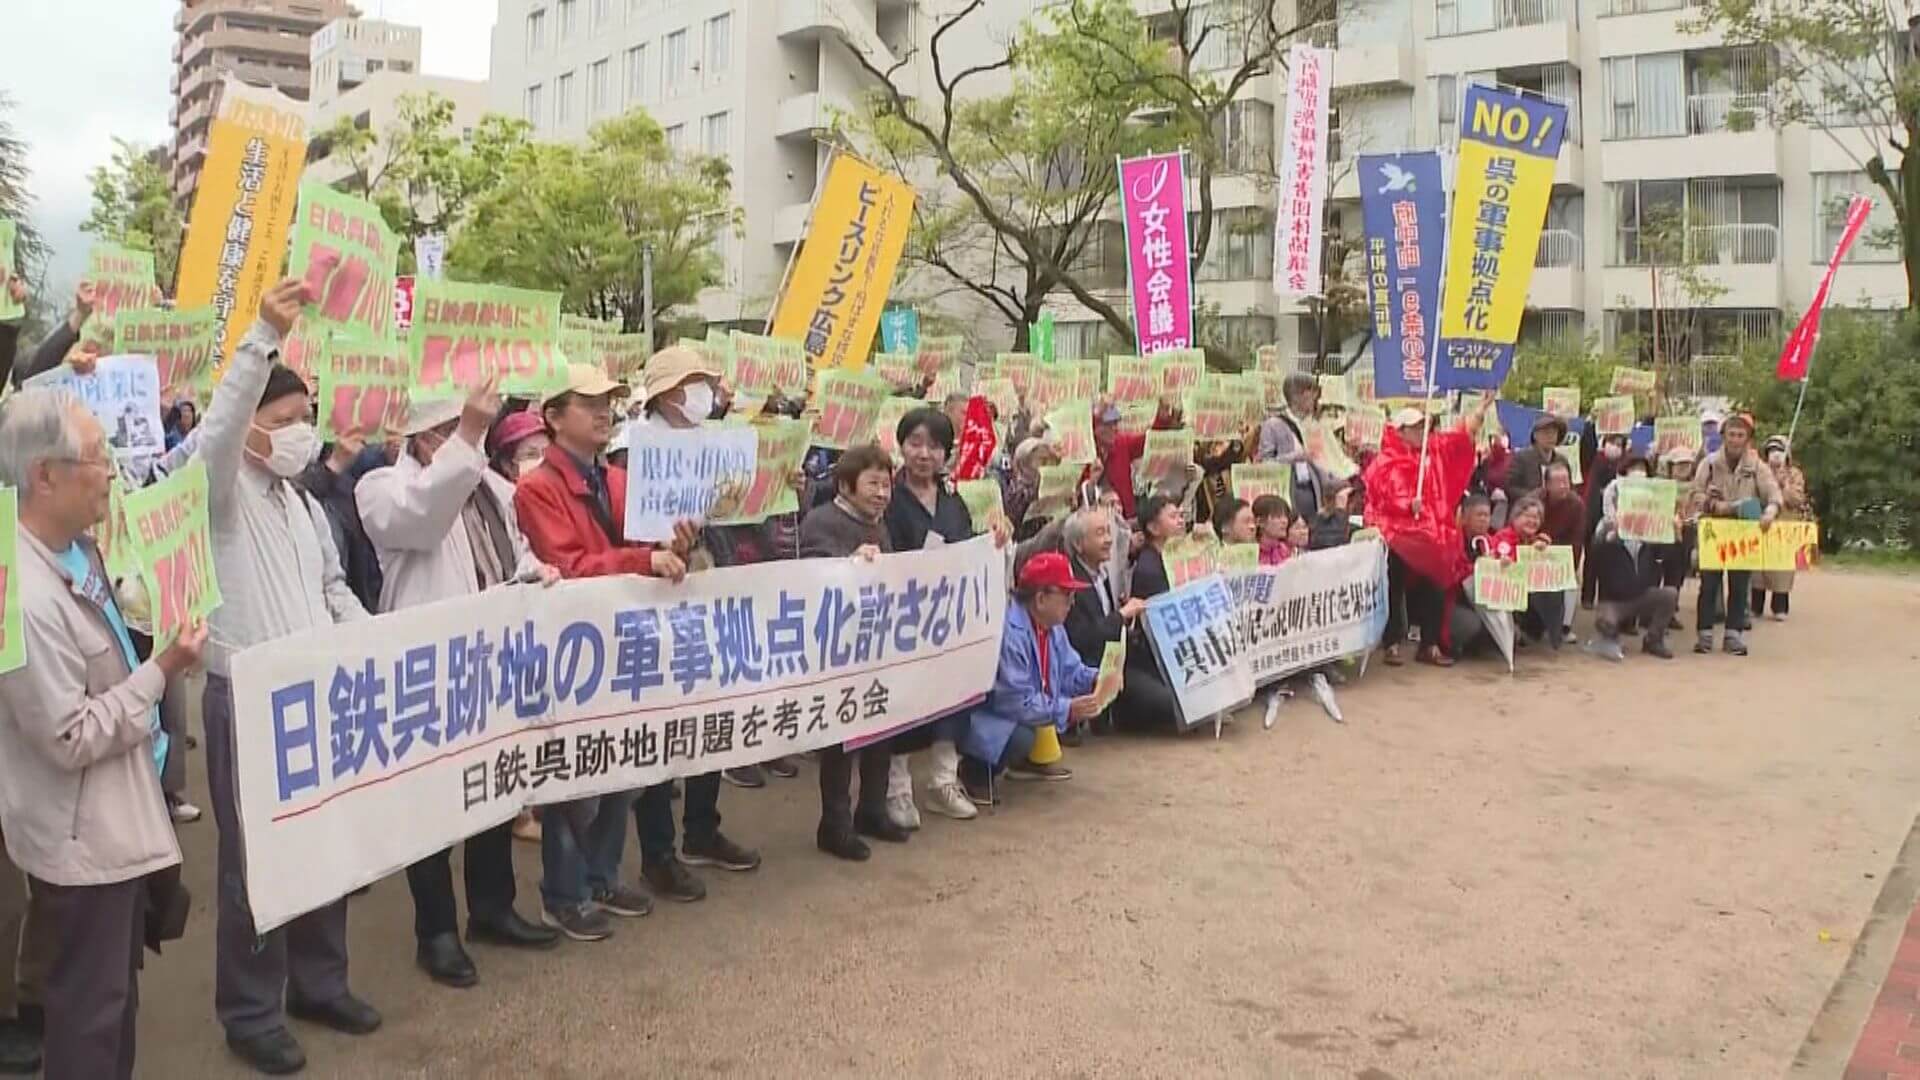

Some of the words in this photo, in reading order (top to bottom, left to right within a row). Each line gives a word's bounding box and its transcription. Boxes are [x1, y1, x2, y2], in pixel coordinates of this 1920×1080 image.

[1472, 99, 1553, 148] NO!
[1139, 201, 1175, 336] 女性会議
[1463, 156, 1517, 332] 呉の軍事拠点化
[271, 565, 990, 802] 日鉄呉跡地の軍事拠点化許さない!
[463, 677, 890, 812] 日鉄呉跡地問題を考える会
